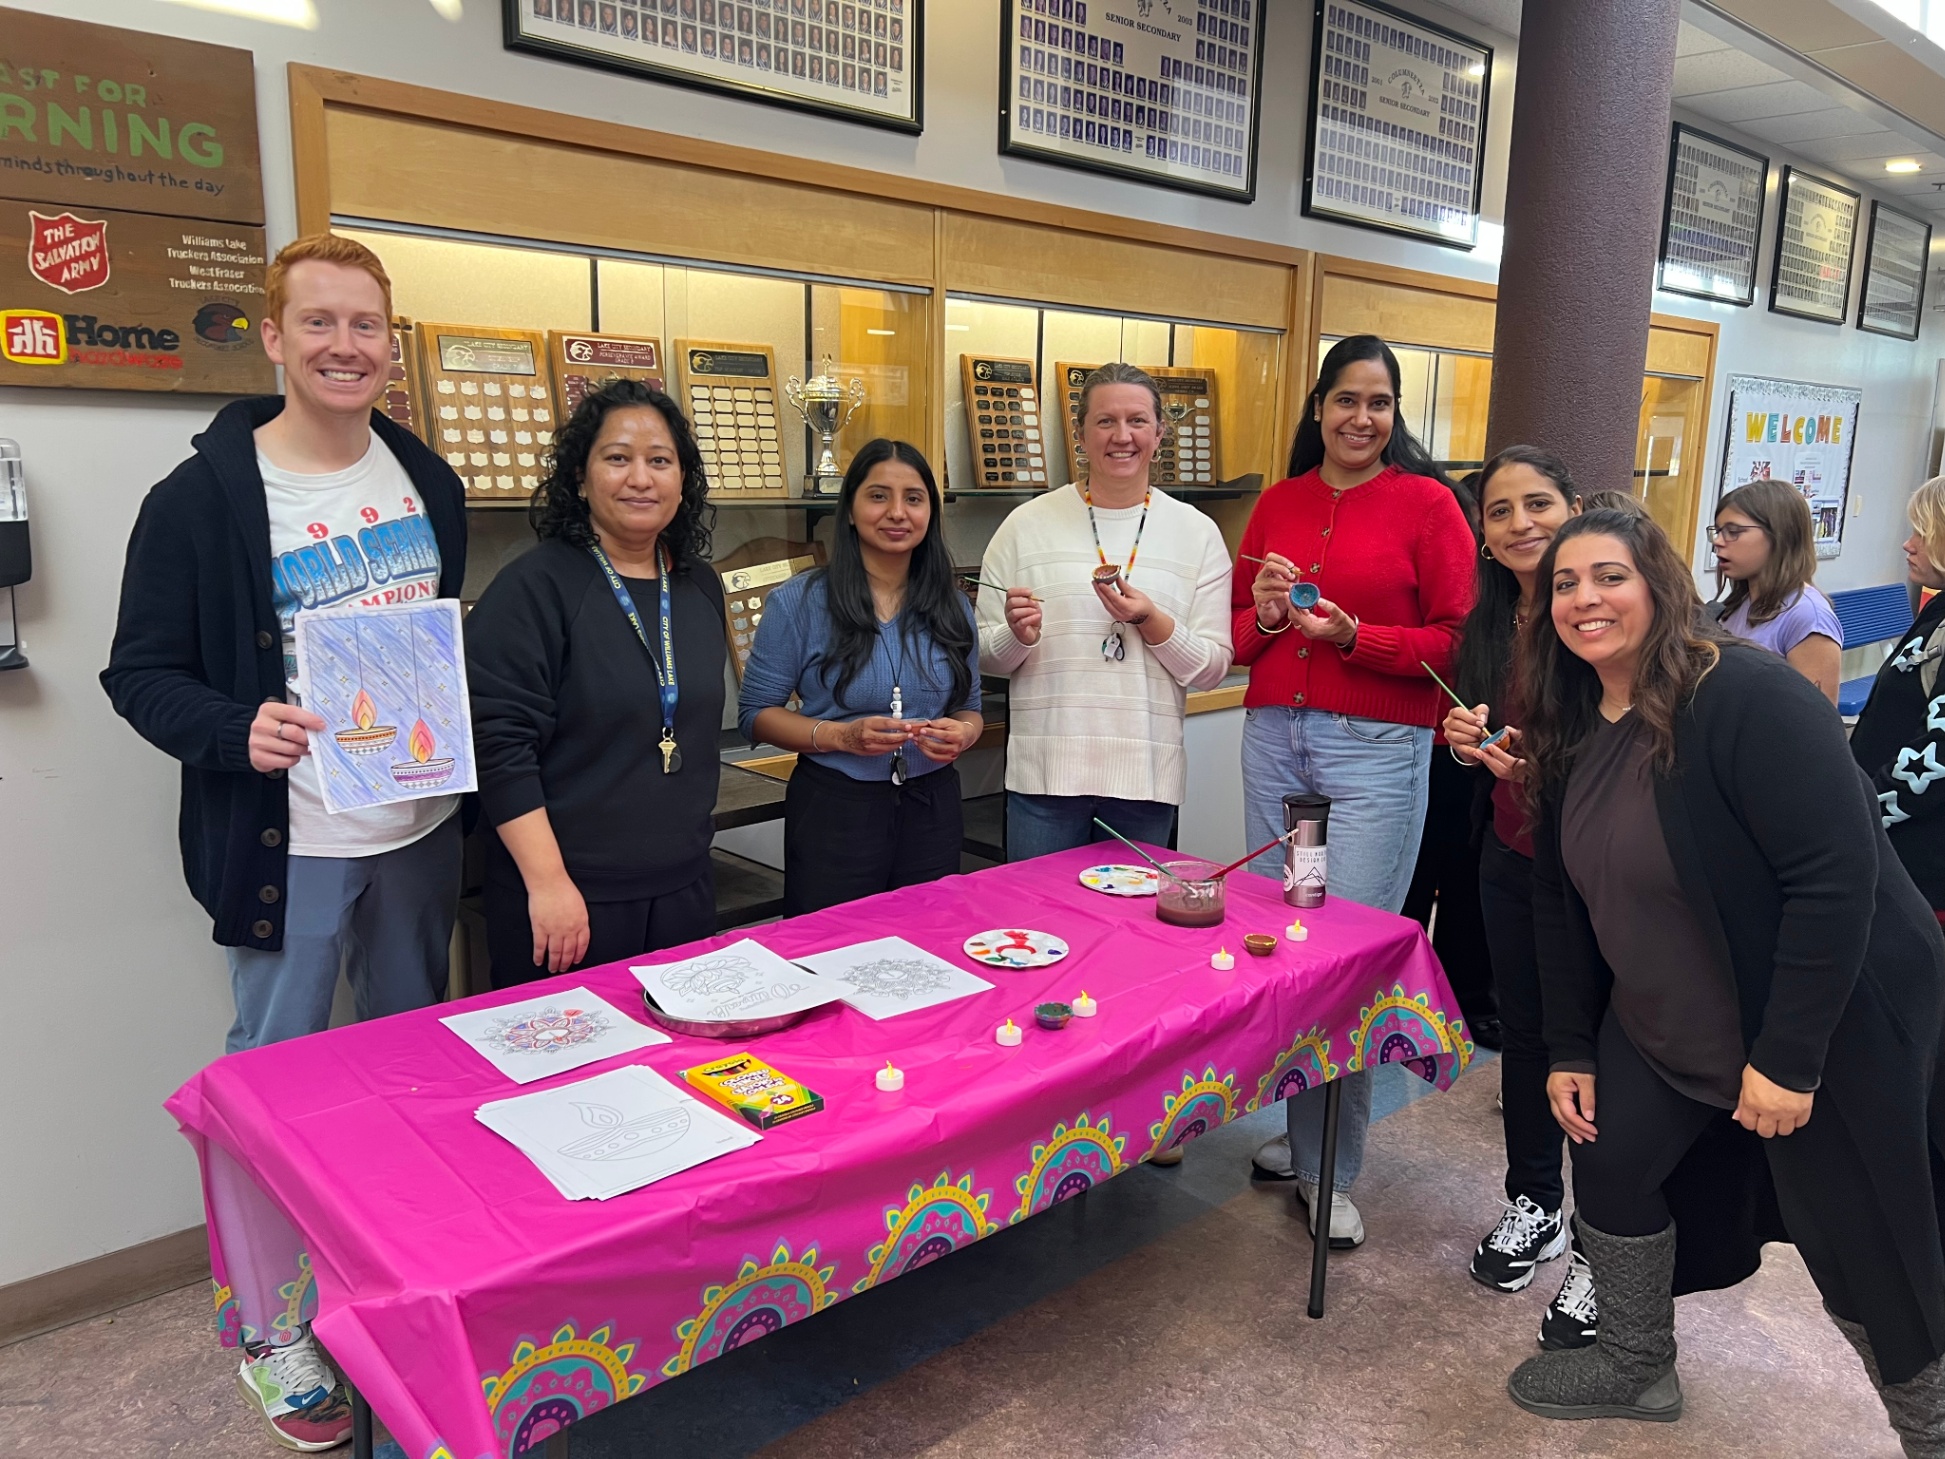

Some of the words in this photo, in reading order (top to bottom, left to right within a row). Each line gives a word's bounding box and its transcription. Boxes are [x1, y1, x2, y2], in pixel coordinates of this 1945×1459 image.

[1106, 12, 1134, 28] SENIOR
[1137, 22, 1181, 42] SECONDARY
[75, 75, 146, 107] FOR
[1379, 96, 1399, 108] SENIOR
[1400, 102, 1430, 118] SECONDARY
[0, 92, 224, 168] RNING
[56, 159, 154, 183] throughout
[157, 170, 189, 188] the
[194, 178, 225, 197] day
[44, 223, 74, 244] THE
[182, 235, 225, 248] Williams
[225, 239, 247, 250] Lake
[34, 231, 100, 270] SALVATION
[167, 248, 209, 261] Truckers
[210, 251, 264, 264] Association
[60, 253, 100, 283] ARMY
[189, 265, 214, 277] West
[215, 268, 245, 279] Fraser
[169, 278, 211, 290] Truckers
[213, 281, 266, 294] Association
[63, 314, 180, 351] Home
[1746, 412, 1843, 445] WELCOME
[604, 566, 614, 574] OF
[610, 575, 621, 589] CITY
[349, 580, 437, 607] MPIONS
[628, 612, 639, 630] LAKE
[663, 631, 670, 640] OF
[664, 640, 673, 670] WILLIAMS
[667, 670, 675, 686] LAKE
[772, 1094, 792, 1104] 24
